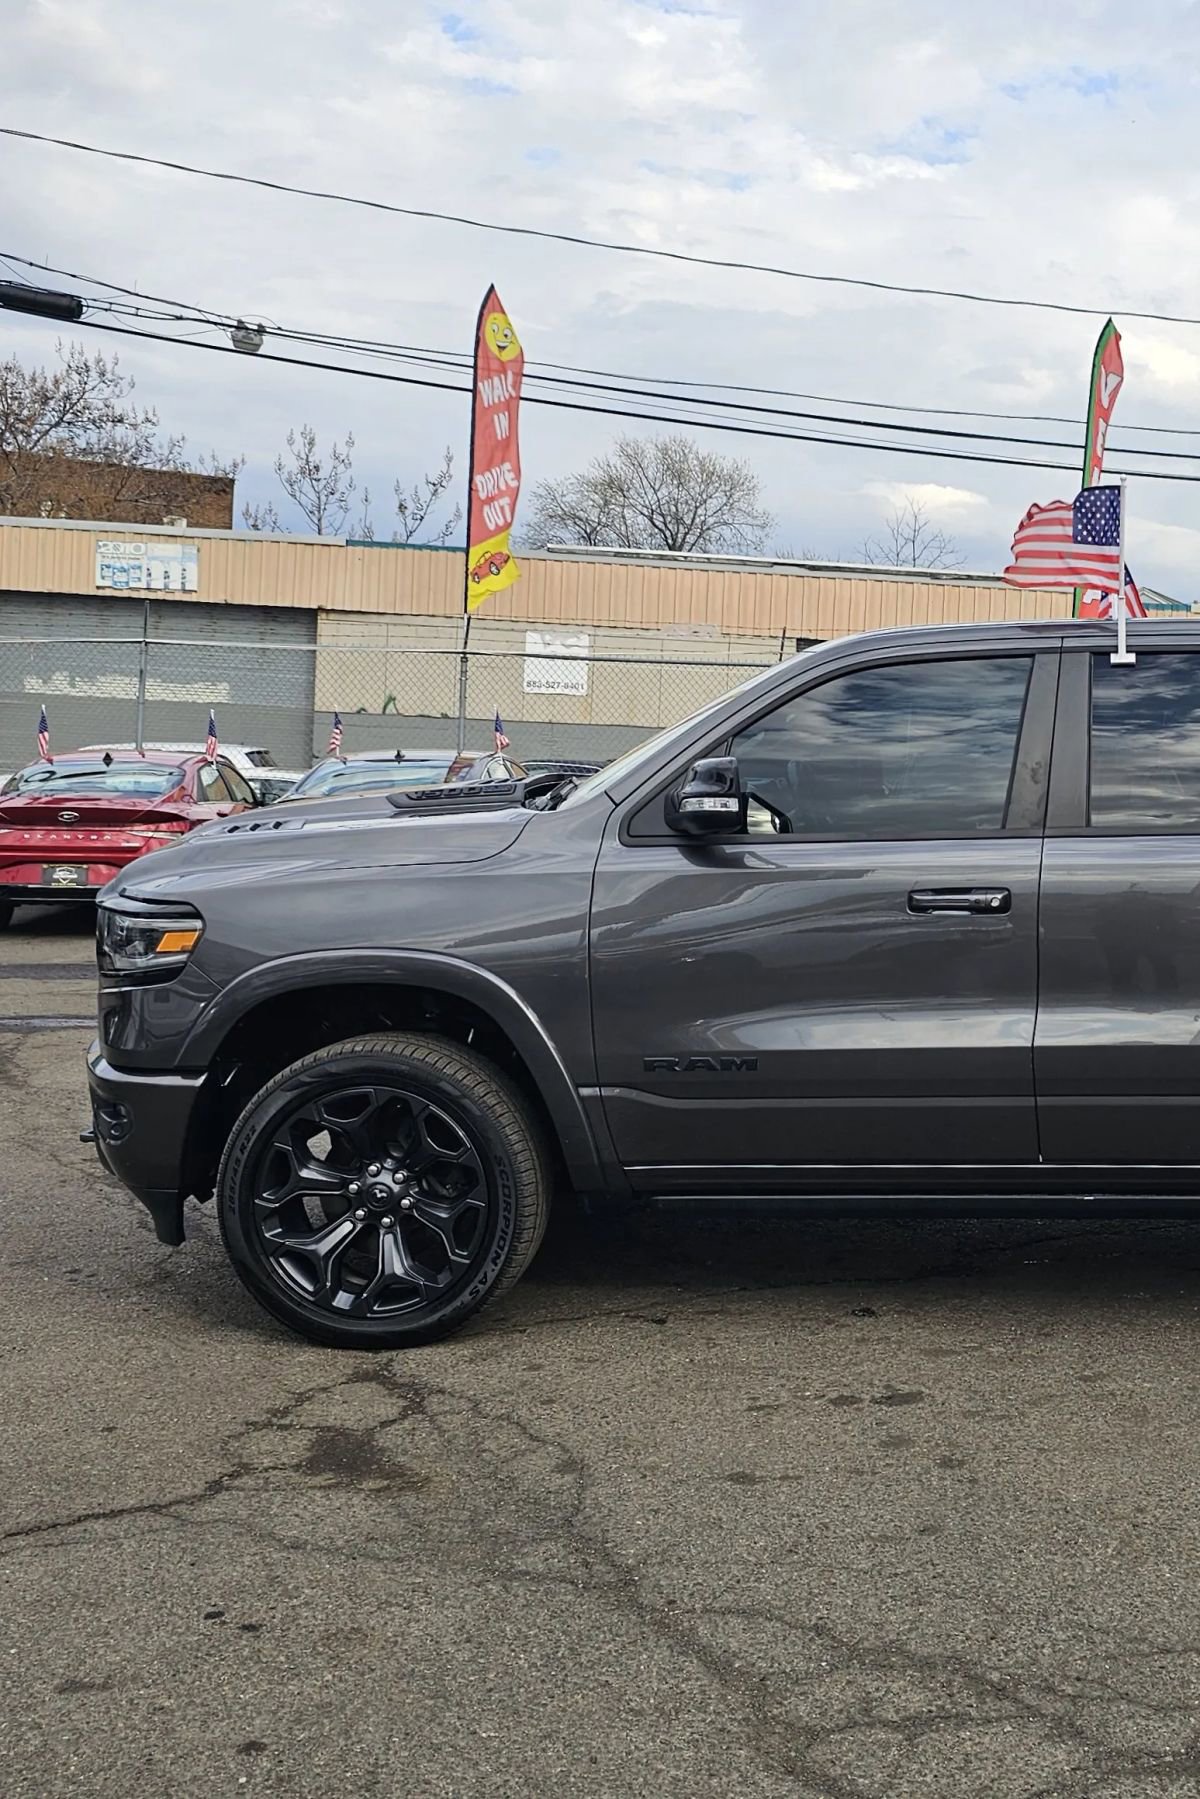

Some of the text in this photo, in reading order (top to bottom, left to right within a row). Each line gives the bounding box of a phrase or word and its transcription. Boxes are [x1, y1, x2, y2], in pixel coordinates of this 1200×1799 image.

[479, 370, 516, 408] WALK
[494, 411, 509, 441] IN
[475, 461, 519, 500] DRIVE
[483, 496, 512, 531] OUT
[643, 1056, 759, 1072] RAM
[492, 1154, 513, 1267] SCORPION
